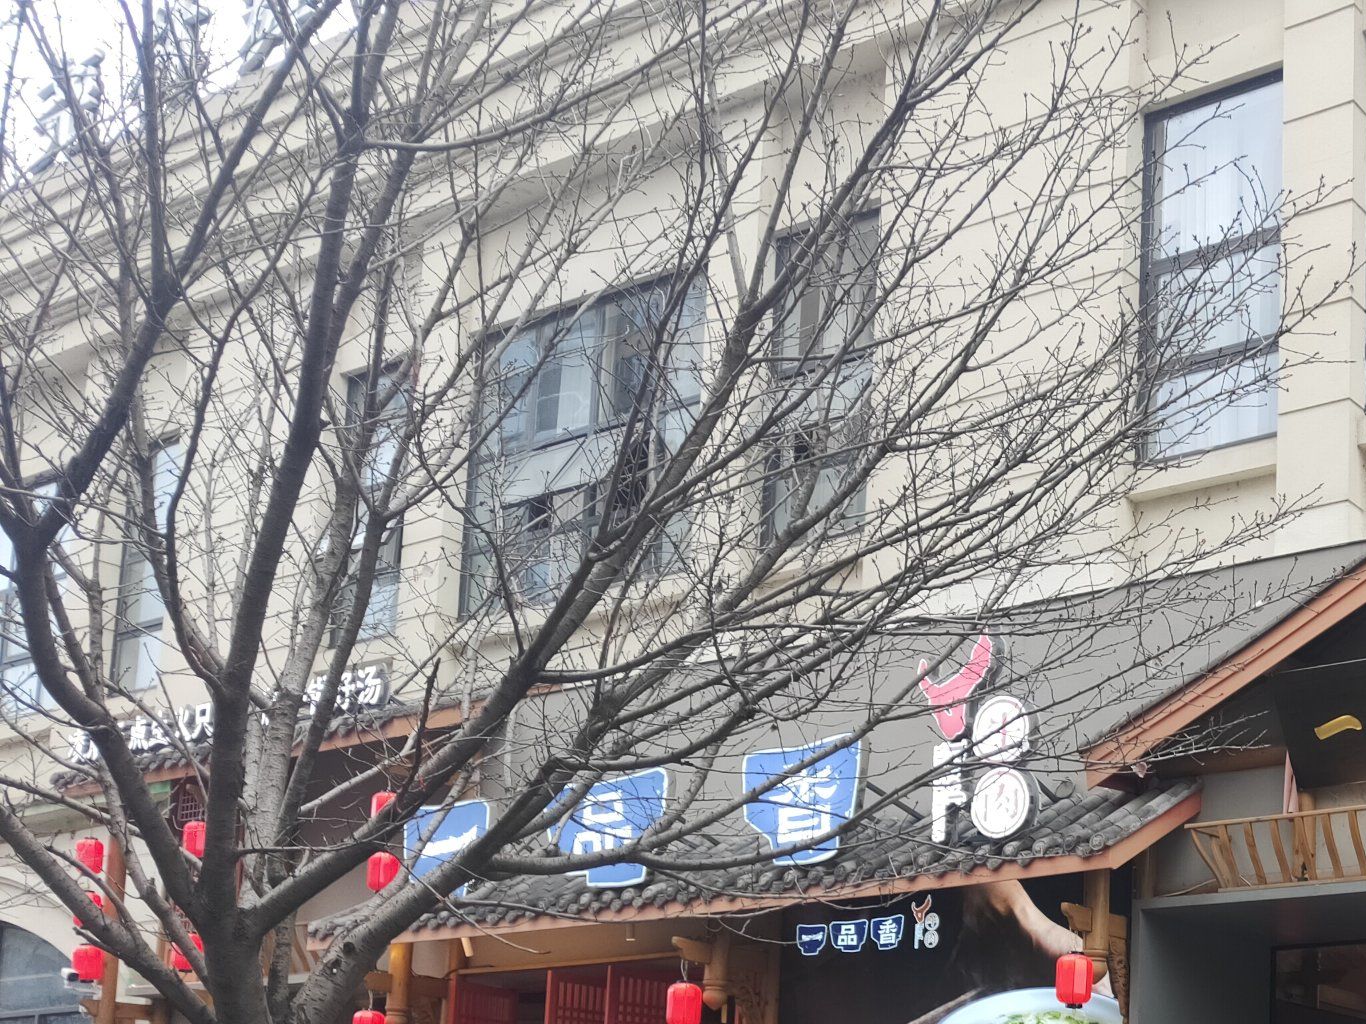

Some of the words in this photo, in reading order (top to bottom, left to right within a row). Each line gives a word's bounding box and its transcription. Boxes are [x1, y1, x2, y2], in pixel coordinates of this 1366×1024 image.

[418, 762, 846, 872] 一品香
[800, 917, 899, 948] 一品香
